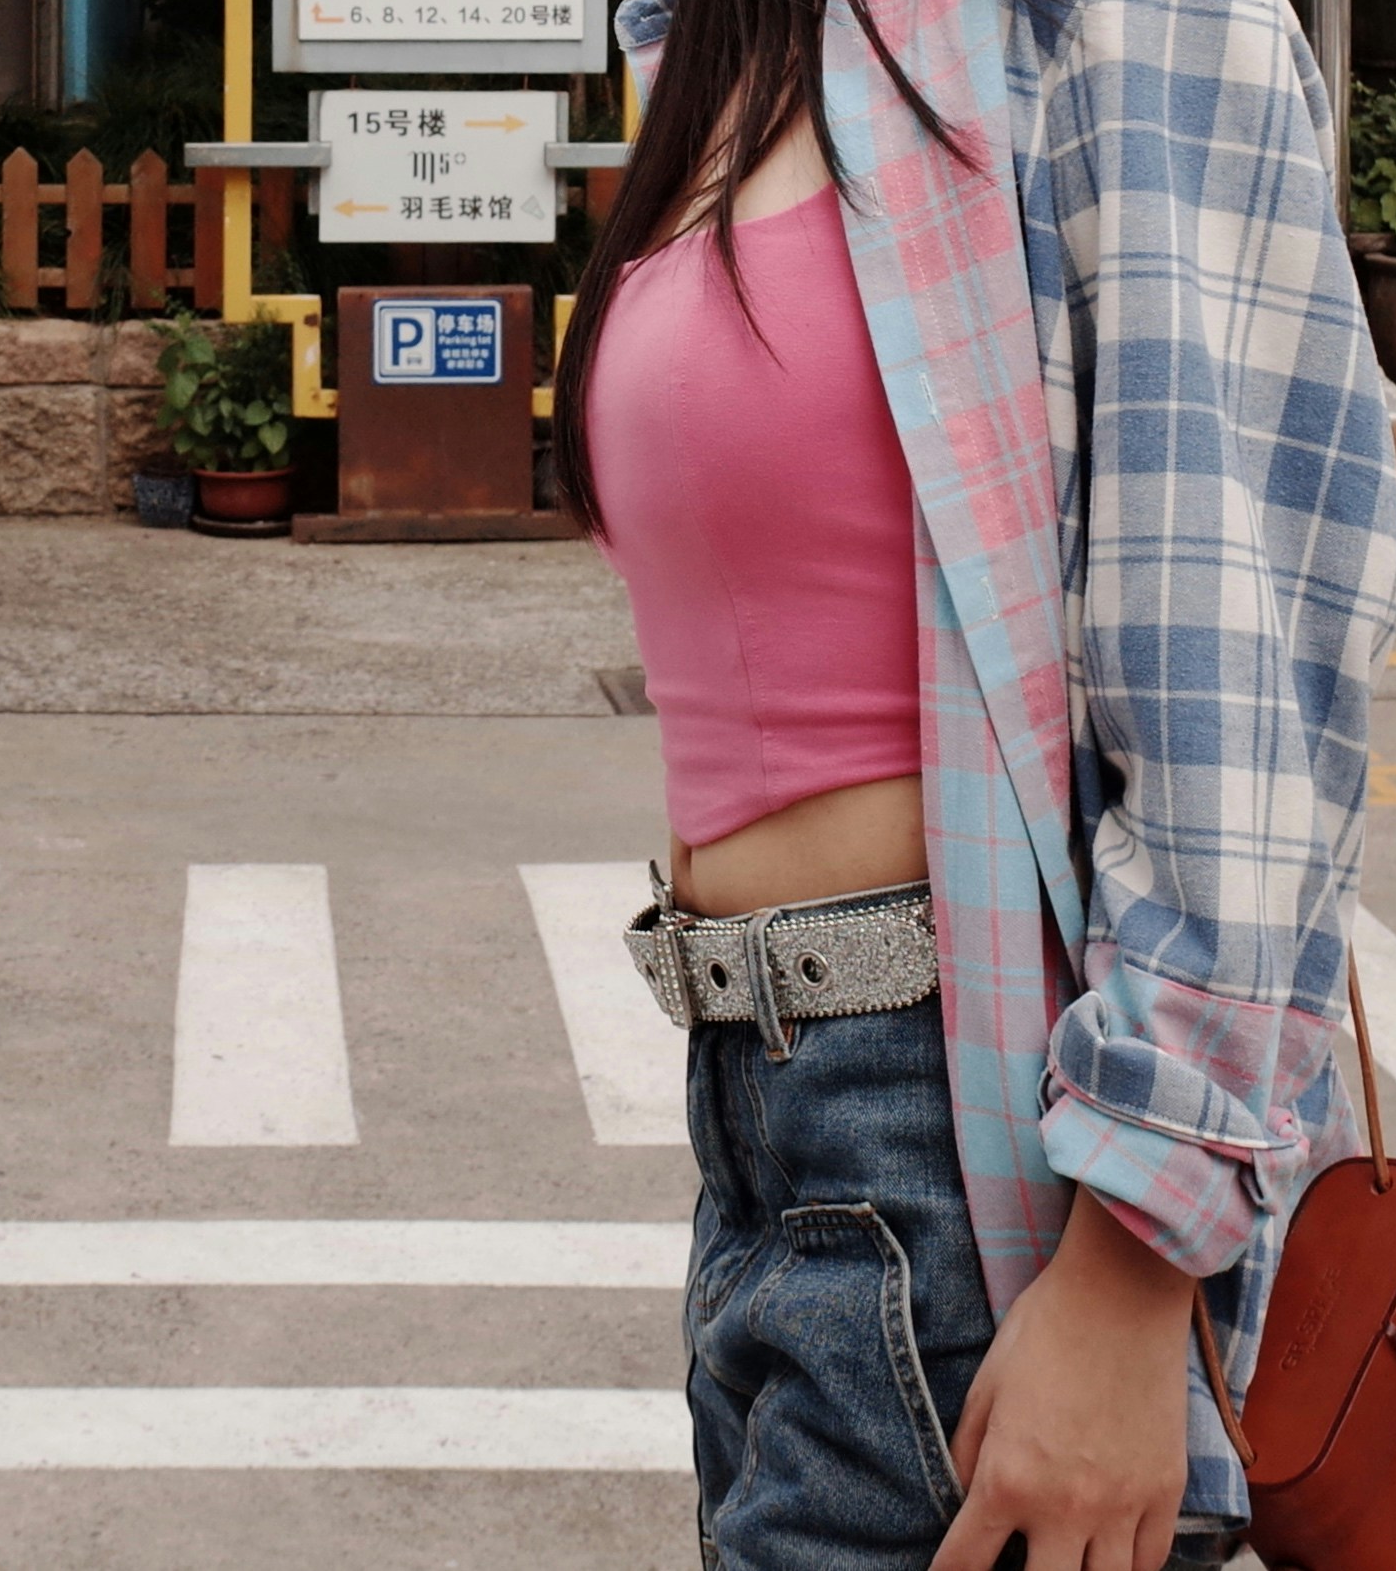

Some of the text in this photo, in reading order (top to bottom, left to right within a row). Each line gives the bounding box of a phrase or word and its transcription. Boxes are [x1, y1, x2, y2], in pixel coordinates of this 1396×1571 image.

[347, 108, 446, 138] 15号楼
[399, 195, 513, 221] 羽毛球馆
[437, 313, 495, 335] 停车场
[391, 316, 424, 367] P
[438, 334, 492, 347] Parking lot
